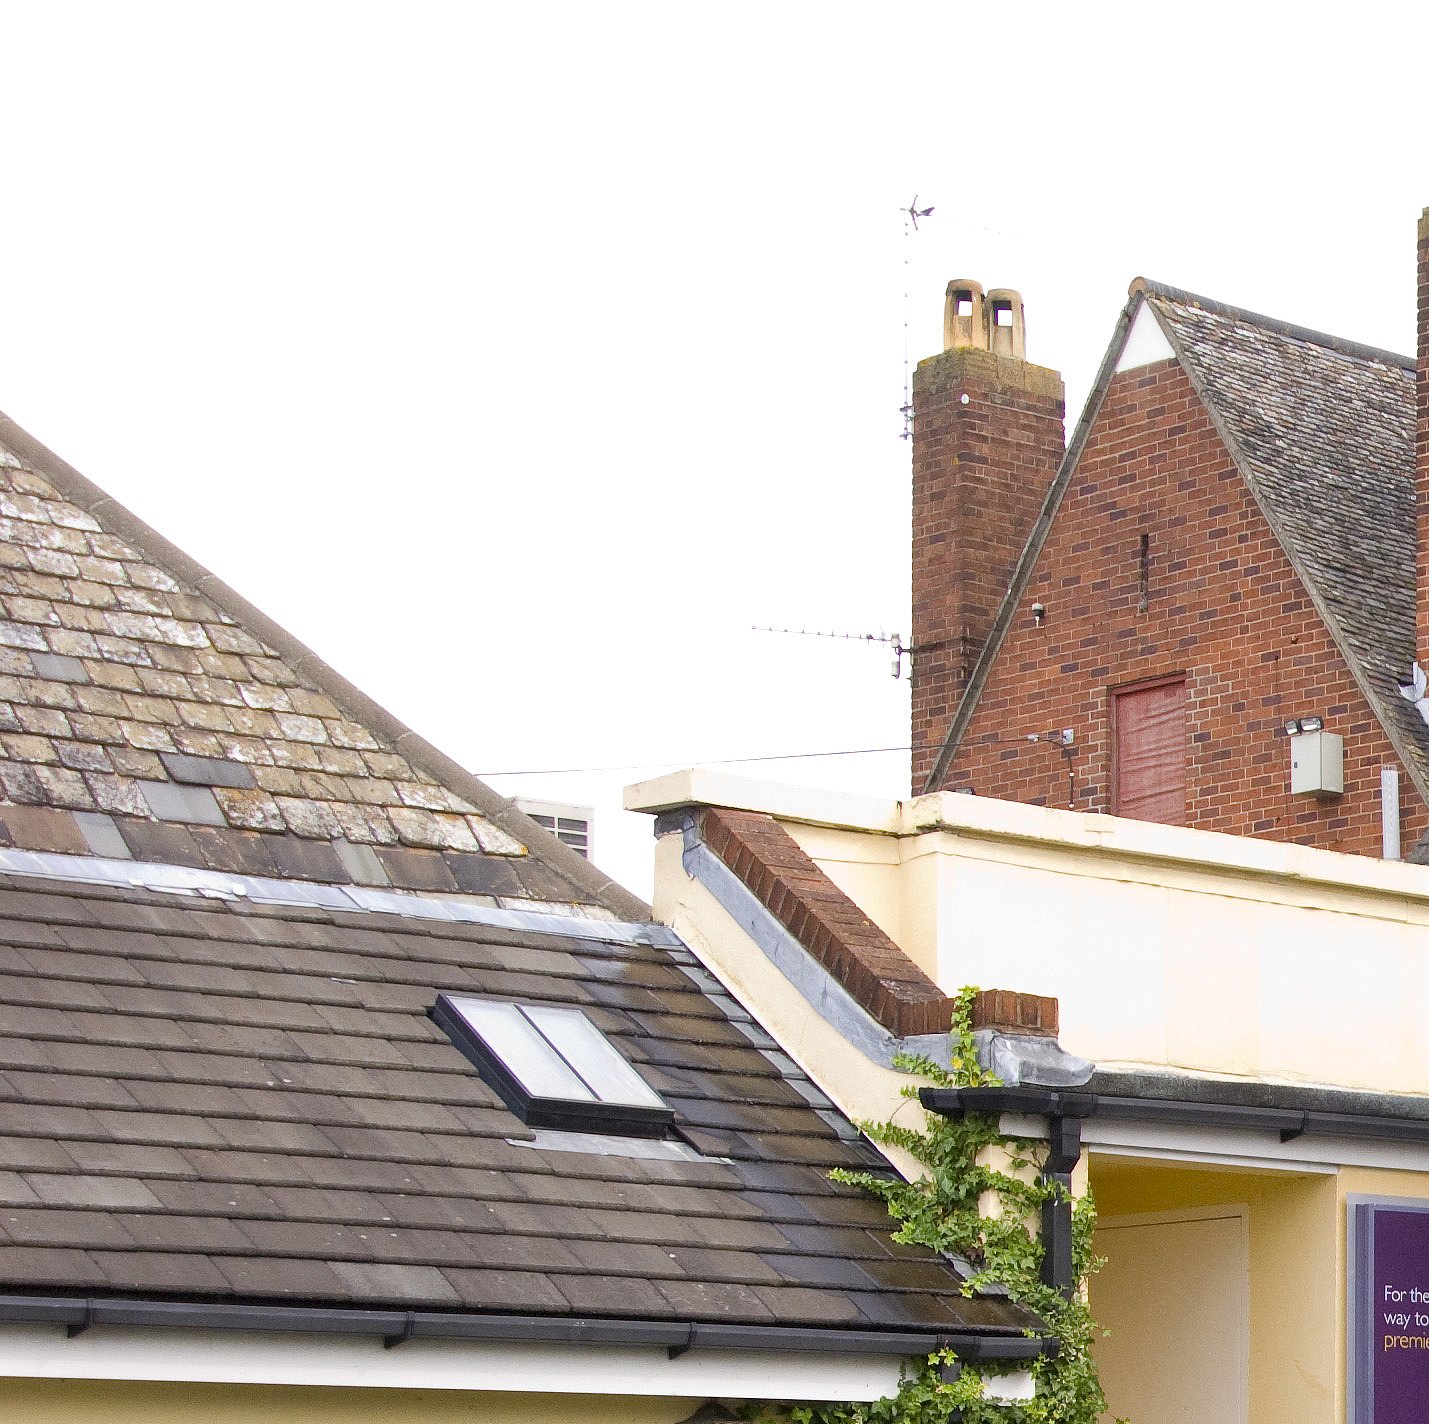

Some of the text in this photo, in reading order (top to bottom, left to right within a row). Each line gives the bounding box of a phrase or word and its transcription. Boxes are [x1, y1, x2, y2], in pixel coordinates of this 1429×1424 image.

[1384, 1285, 1407, 1302] For
[1383, 1312, 1411, 1330] way
[1414, 1311, 1429, 1327] to
